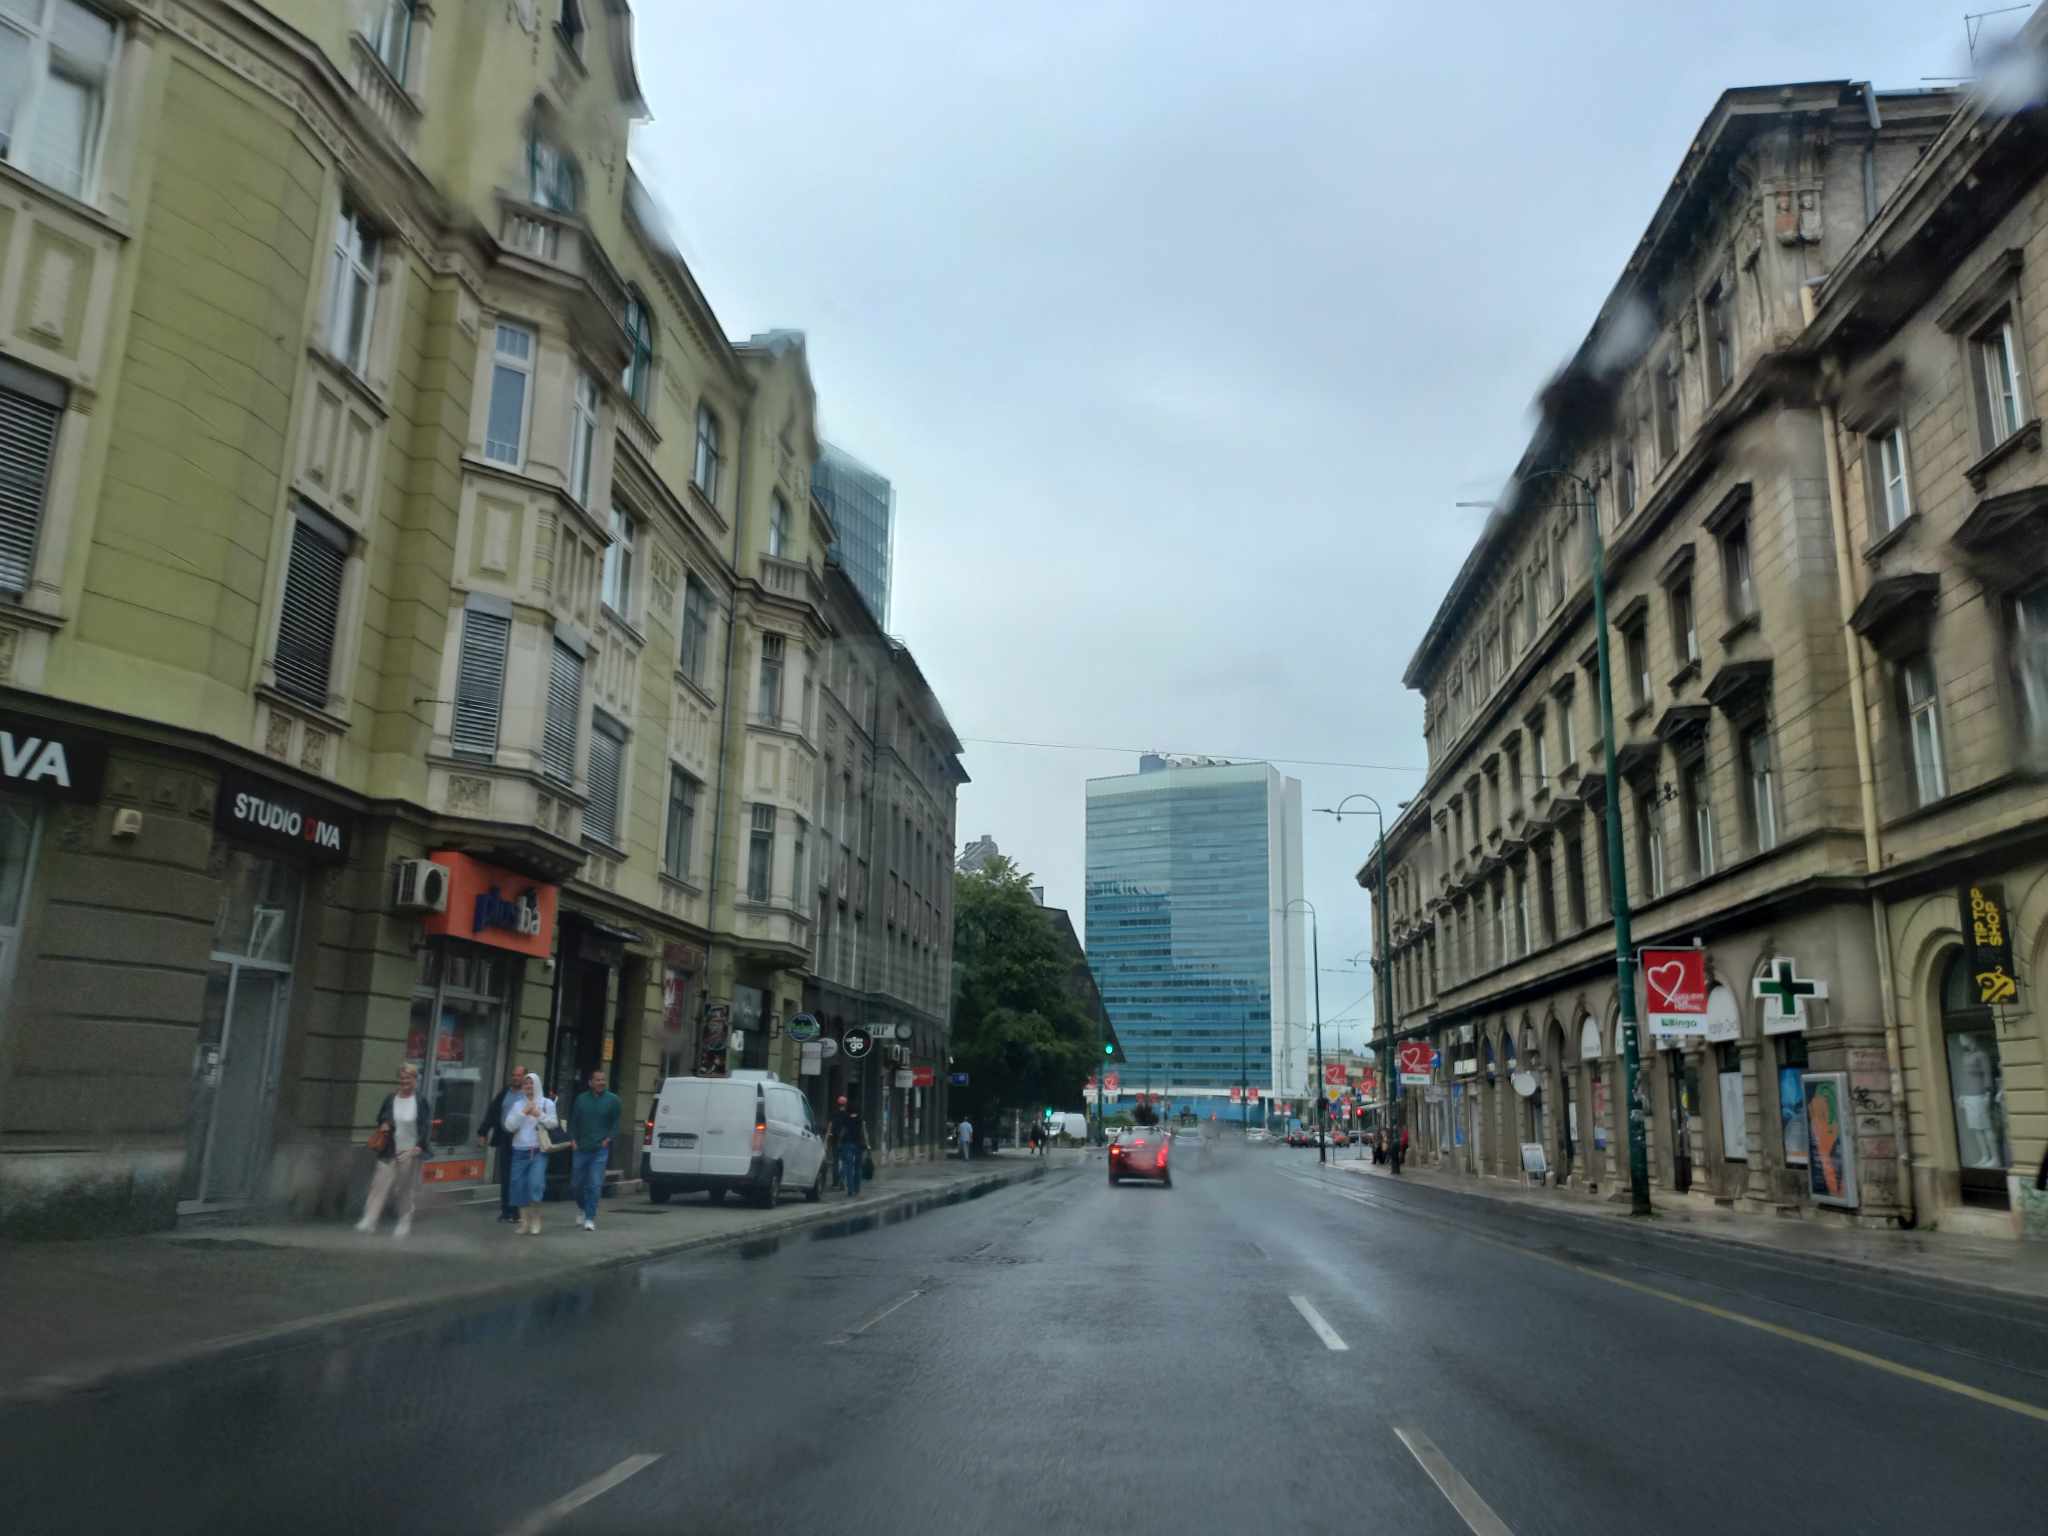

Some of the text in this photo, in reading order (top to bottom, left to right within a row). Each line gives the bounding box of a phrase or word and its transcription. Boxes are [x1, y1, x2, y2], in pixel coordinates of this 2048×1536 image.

[233, 792, 341, 850] STUDIO DIVA
[1970, 887, 1988, 946] TIP TOP
[1985, 901, 2003, 946] SHOP
[849, 1041, 864, 1053] go
